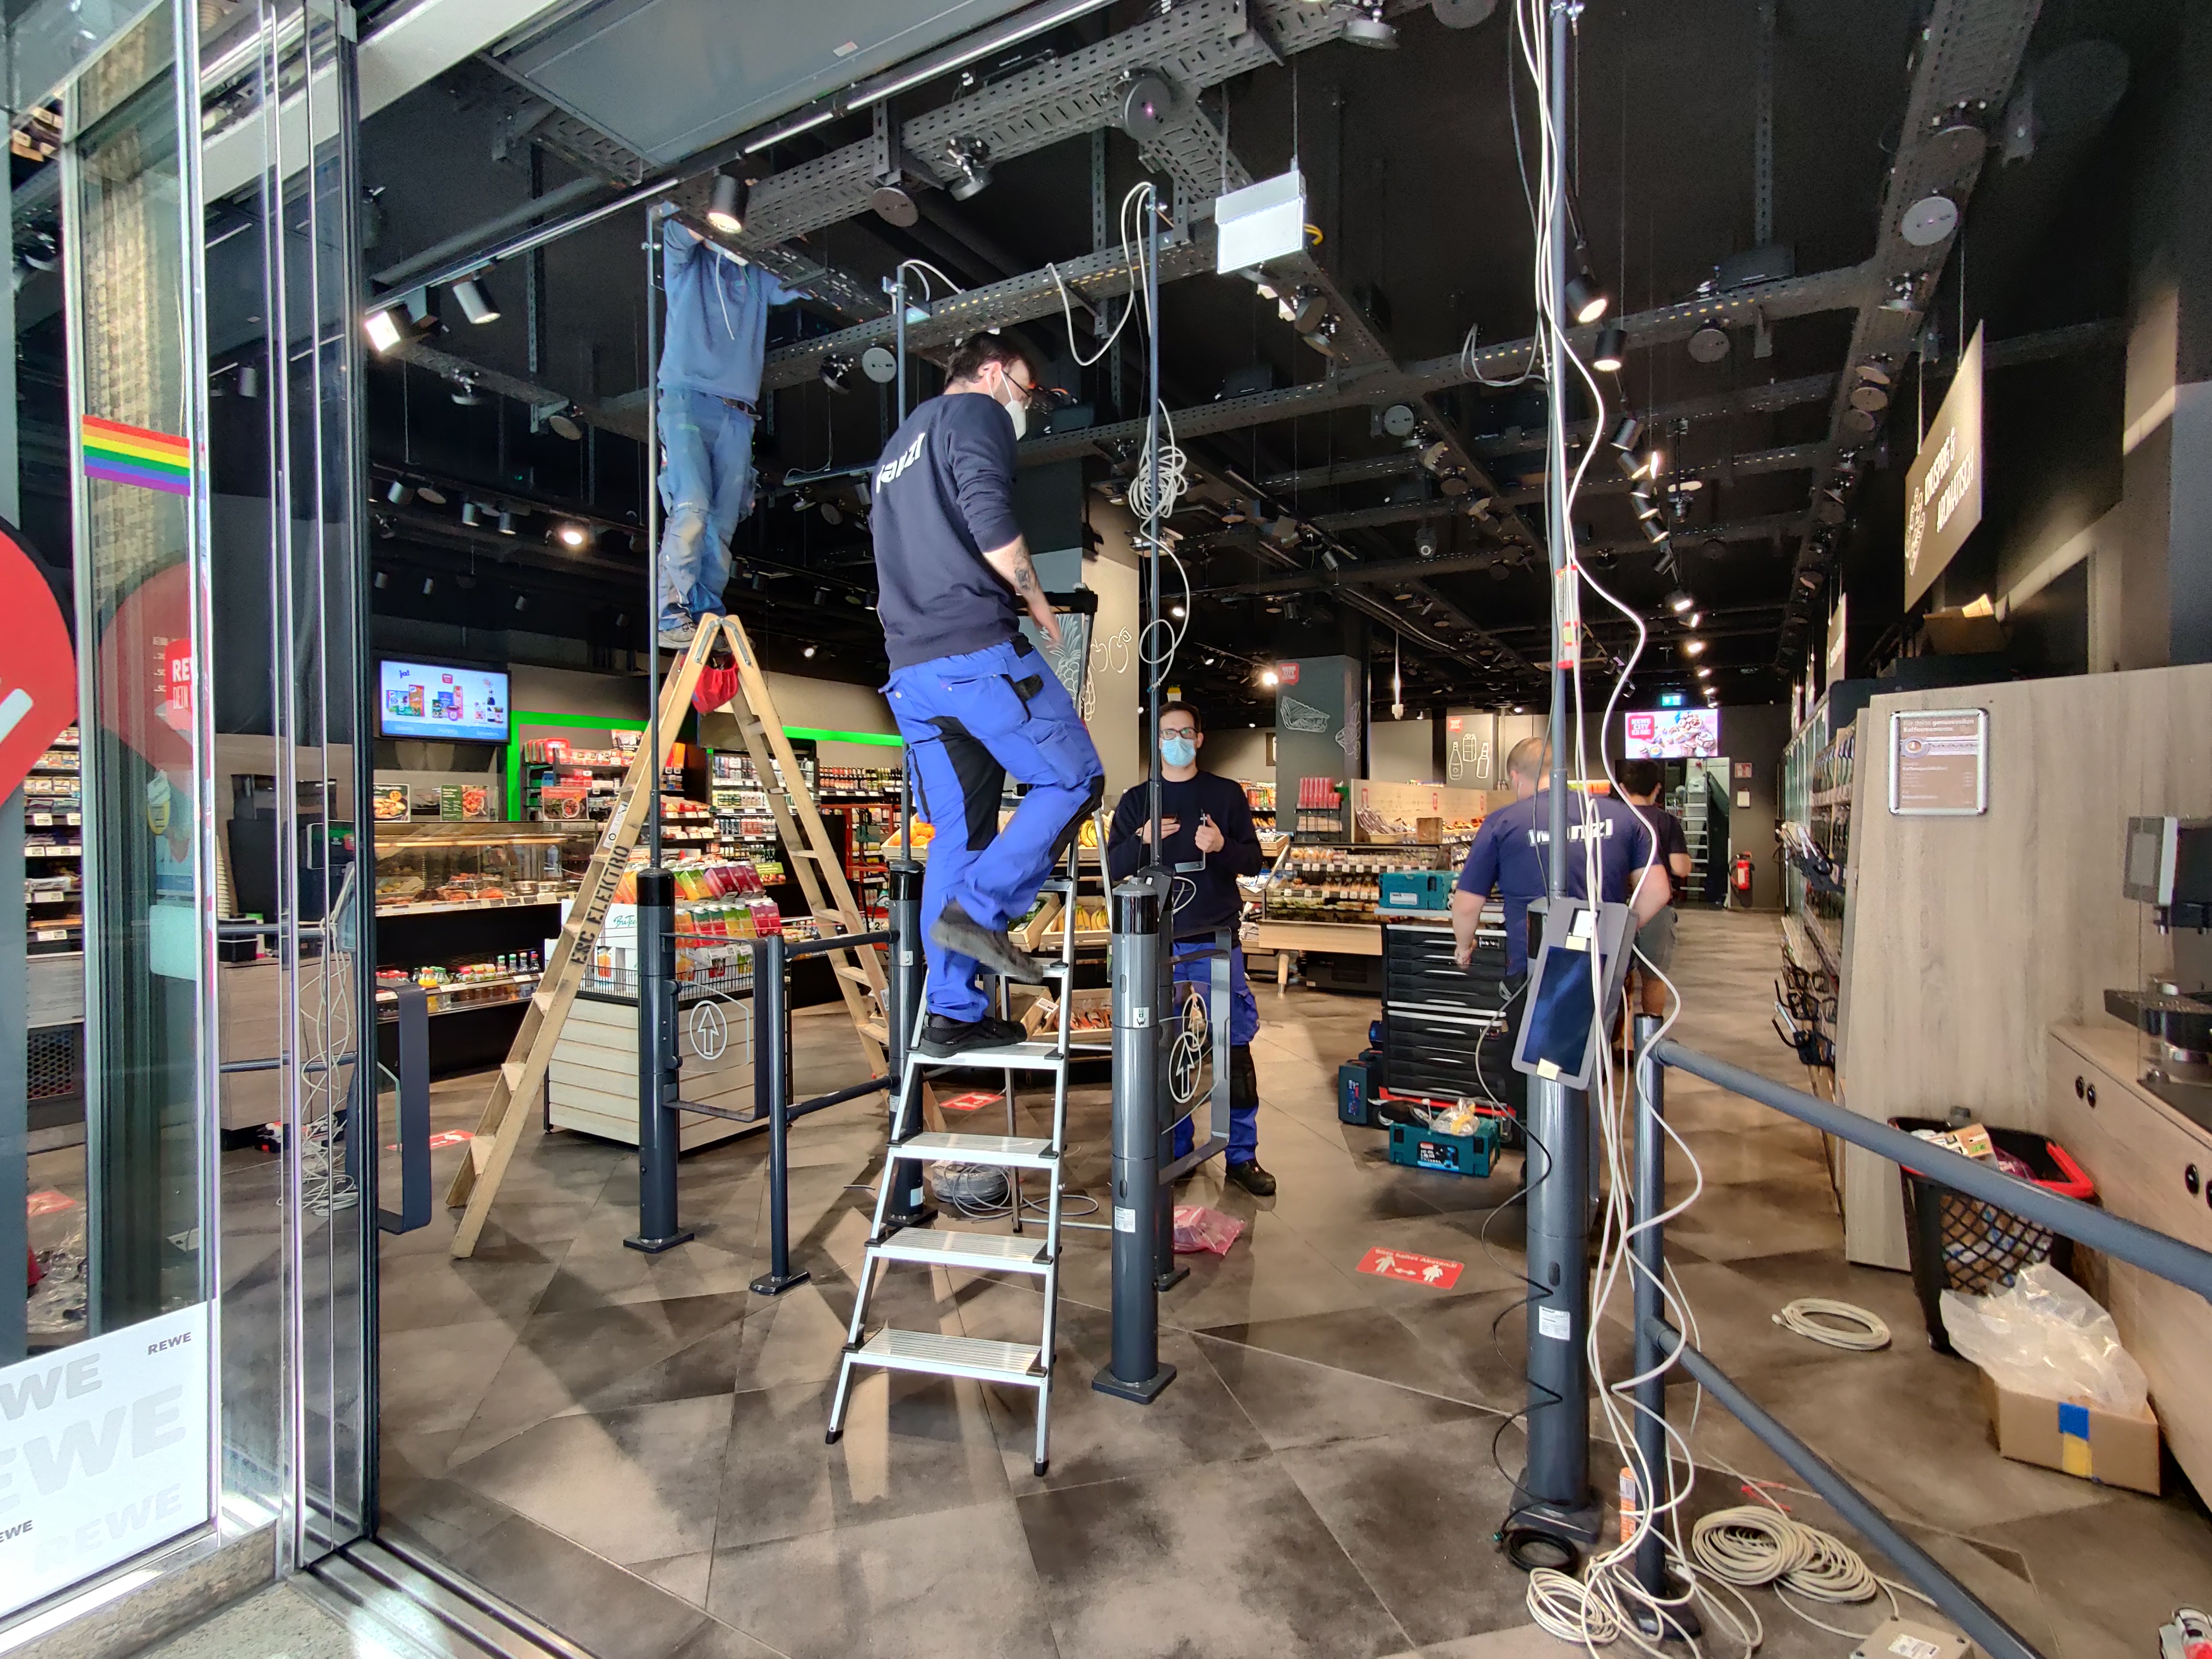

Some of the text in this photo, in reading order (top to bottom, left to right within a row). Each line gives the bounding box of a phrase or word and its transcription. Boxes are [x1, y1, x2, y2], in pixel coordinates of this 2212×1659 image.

[1936, 446, 1974, 533] AROMATISCH
[172, 657, 192, 683] RE
[399, 670, 409, 679] ja!
[173, 685, 189, 709] DEIN
[586, 845, 630, 925] ELEKTRO
[1375, 1248, 1394, 1257] Bitte
[1420, 1257, 1457, 1269] Abstand!
[147, 1332, 191, 1355] REWE
